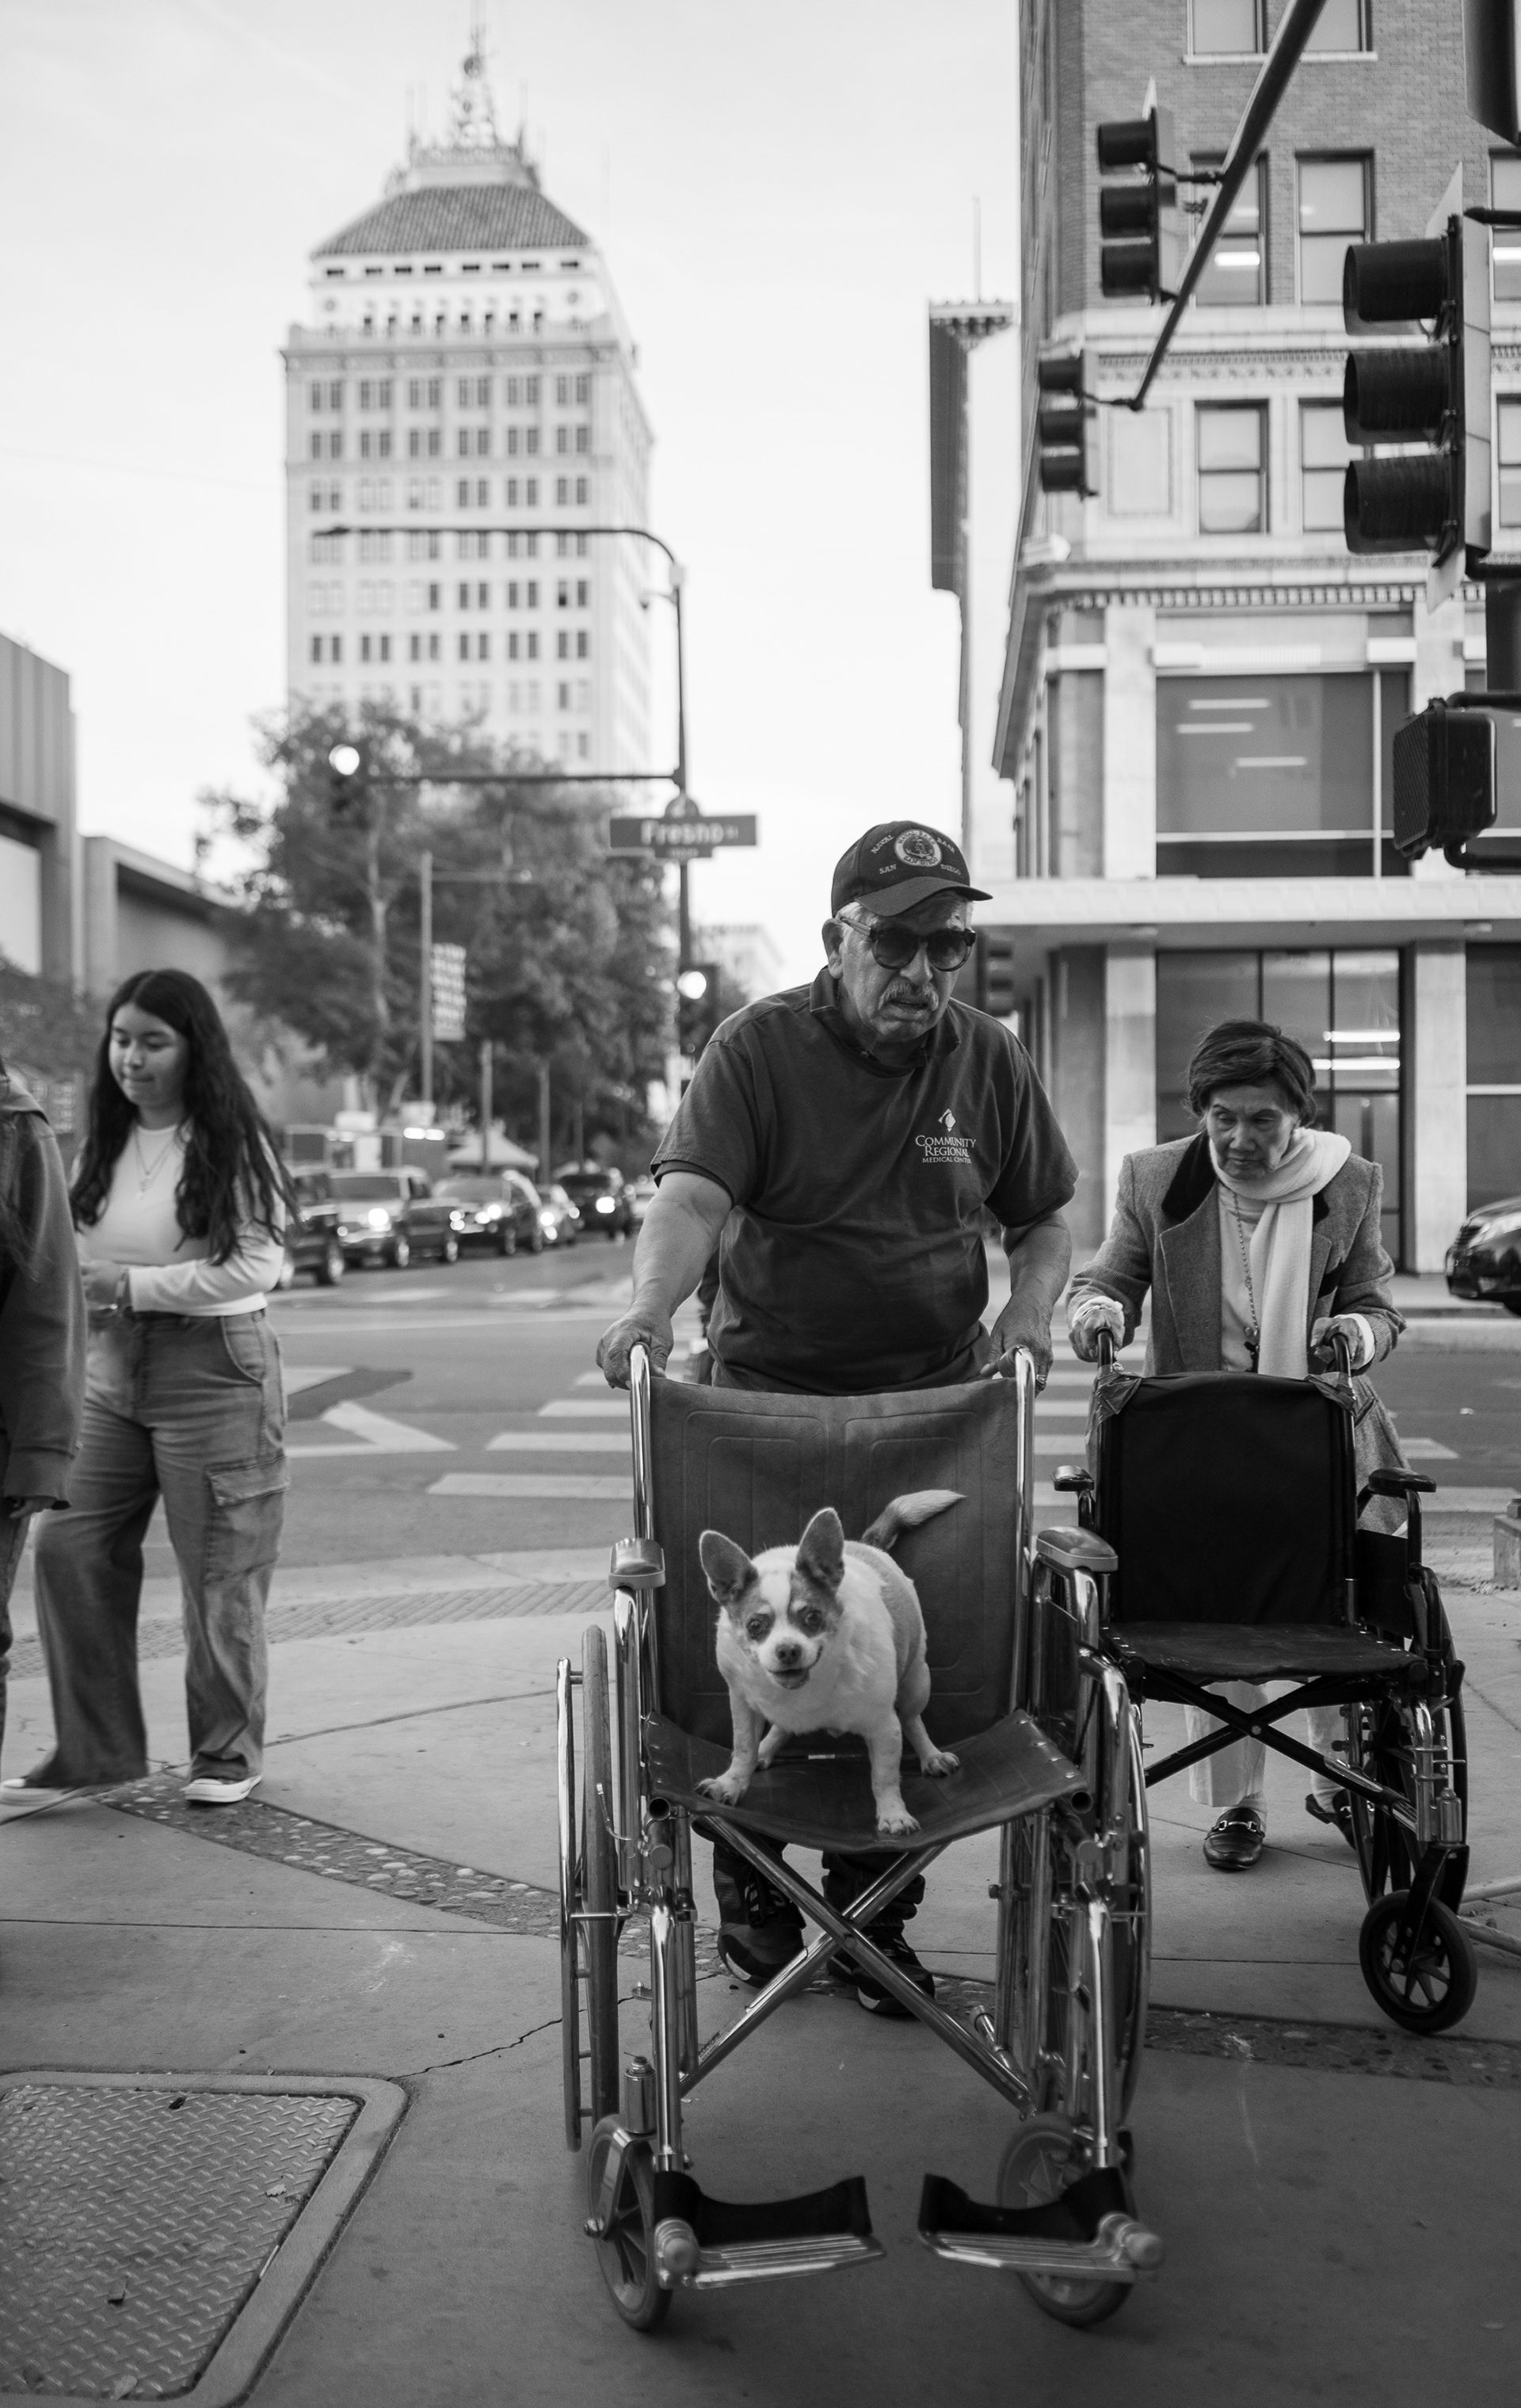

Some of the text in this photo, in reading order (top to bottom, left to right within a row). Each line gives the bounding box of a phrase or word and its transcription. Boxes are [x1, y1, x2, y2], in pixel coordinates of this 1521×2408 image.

[641, 820, 723, 845] Fresno
[871, 834, 955, 853] NAVAL BASE
[879, 864, 896, 874] SAN
[915, 1135, 976, 1148] COMMUNITY
[924, 1146, 970, 1157] REGIONAL
